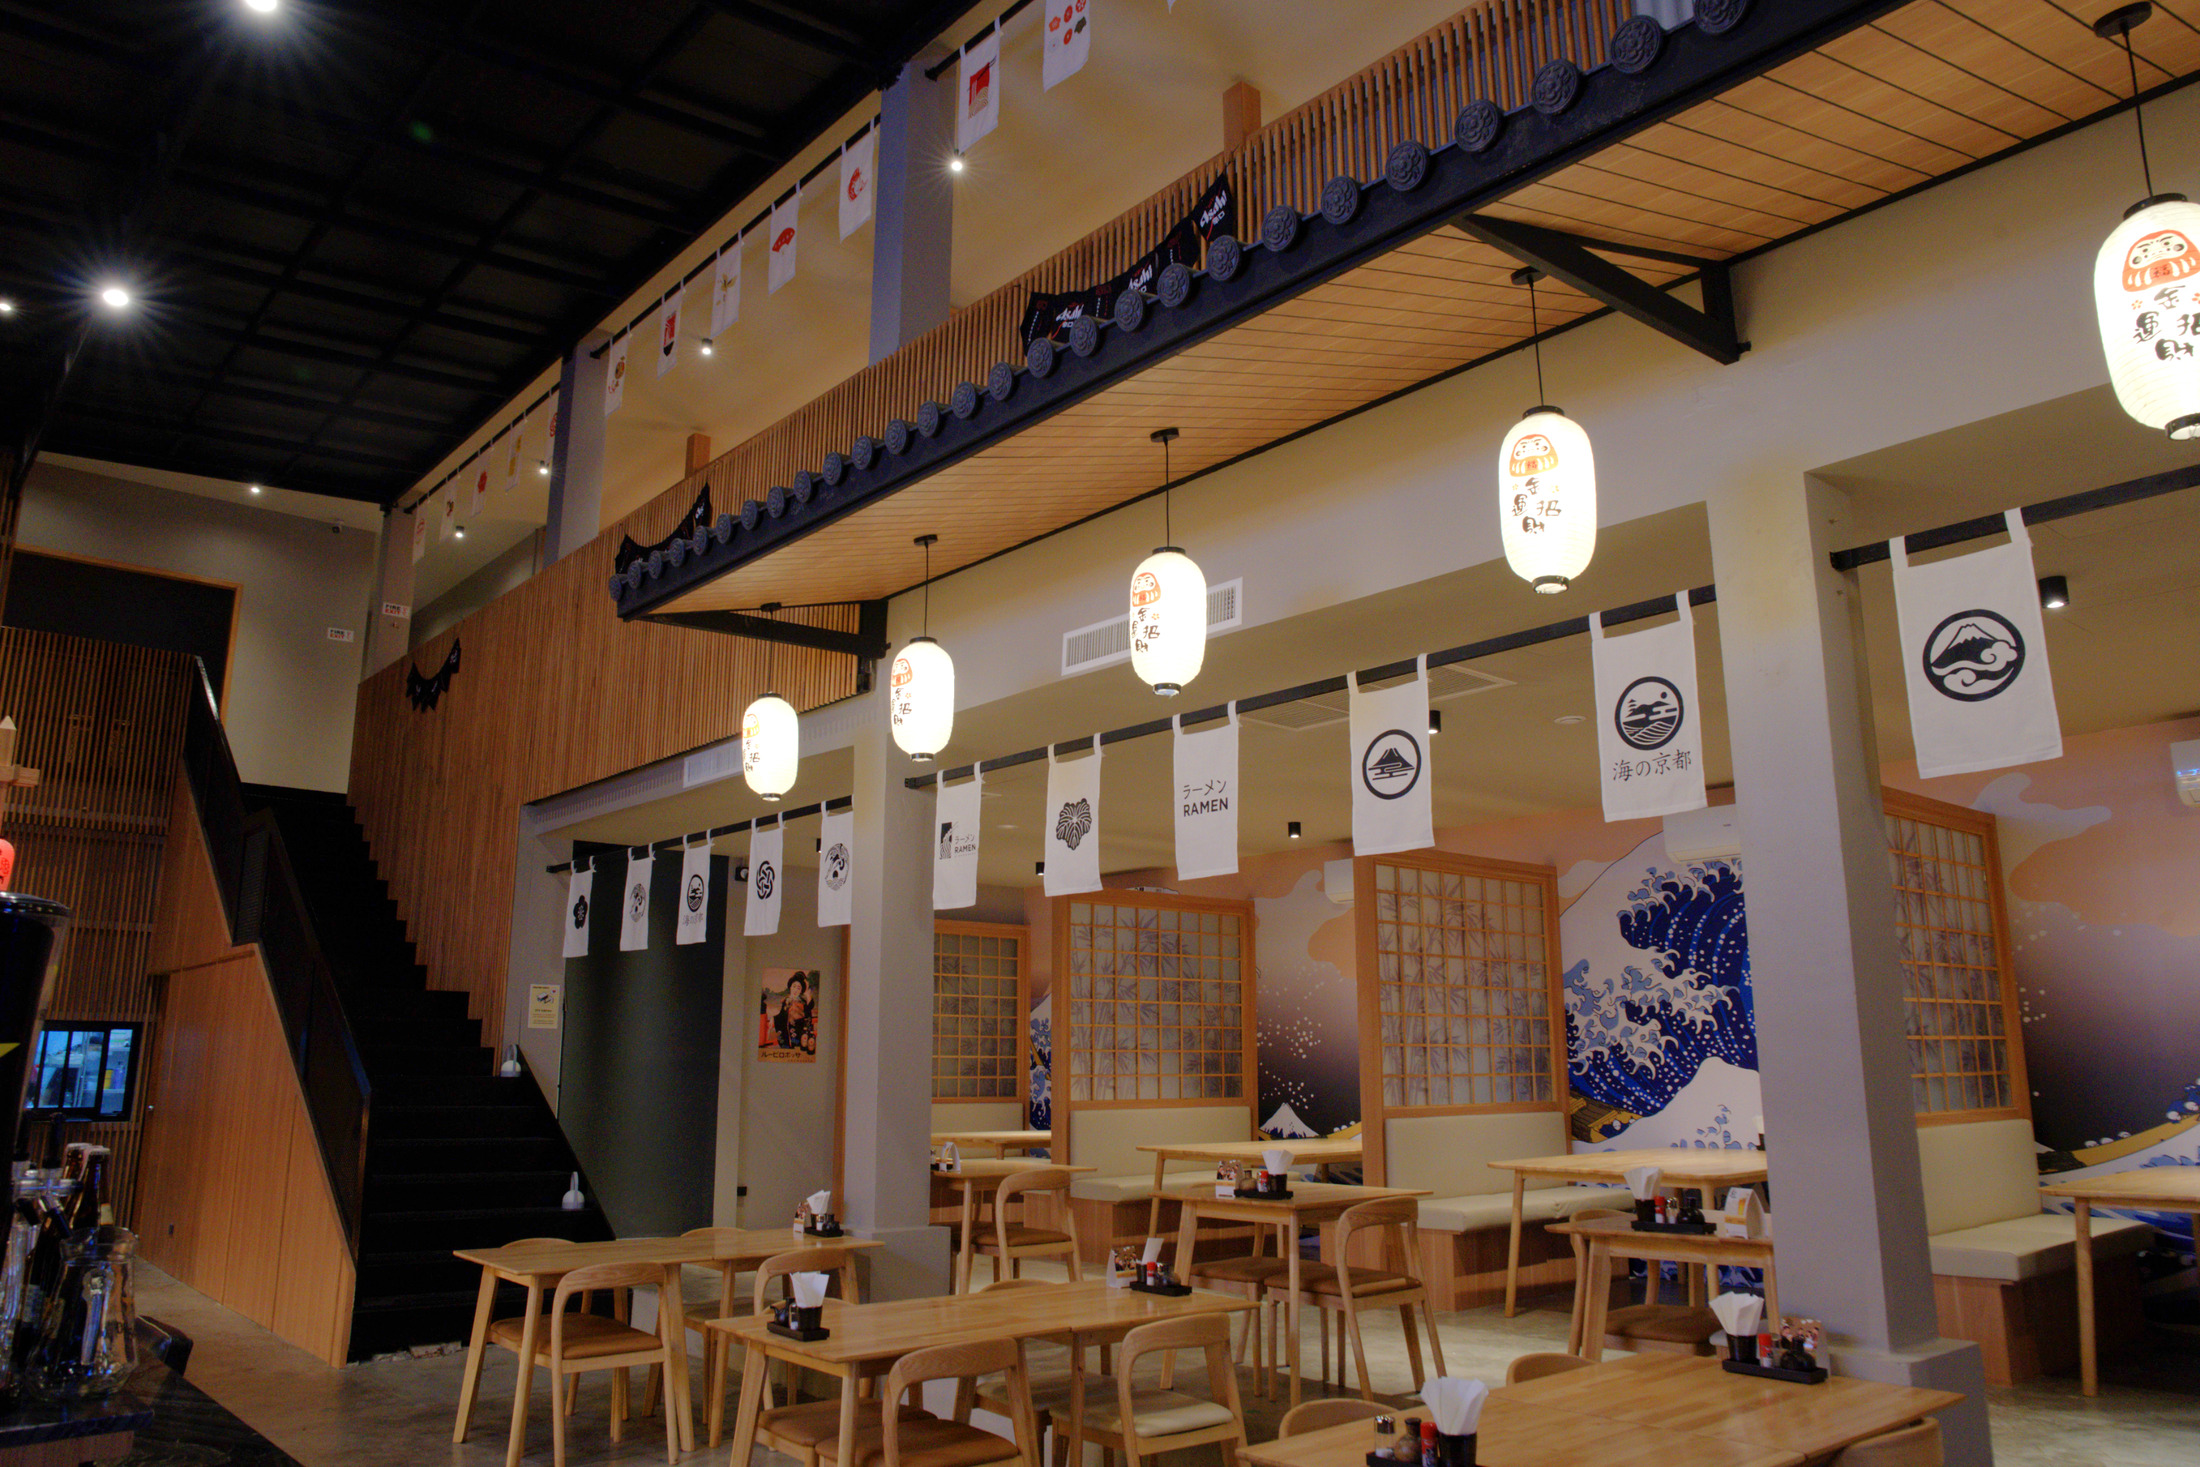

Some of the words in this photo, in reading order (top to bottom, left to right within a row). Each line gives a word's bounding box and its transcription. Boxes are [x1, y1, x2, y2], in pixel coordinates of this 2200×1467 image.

[1200, 190, 1227, 227] Asahi
[1613, 749, 1691, 781] 海の京都
[1183, 779, 1227, 800] ラーメン
[1183, 797, 1228, 817] RAMEN
[954, 844, 976, 853] RAMEN
